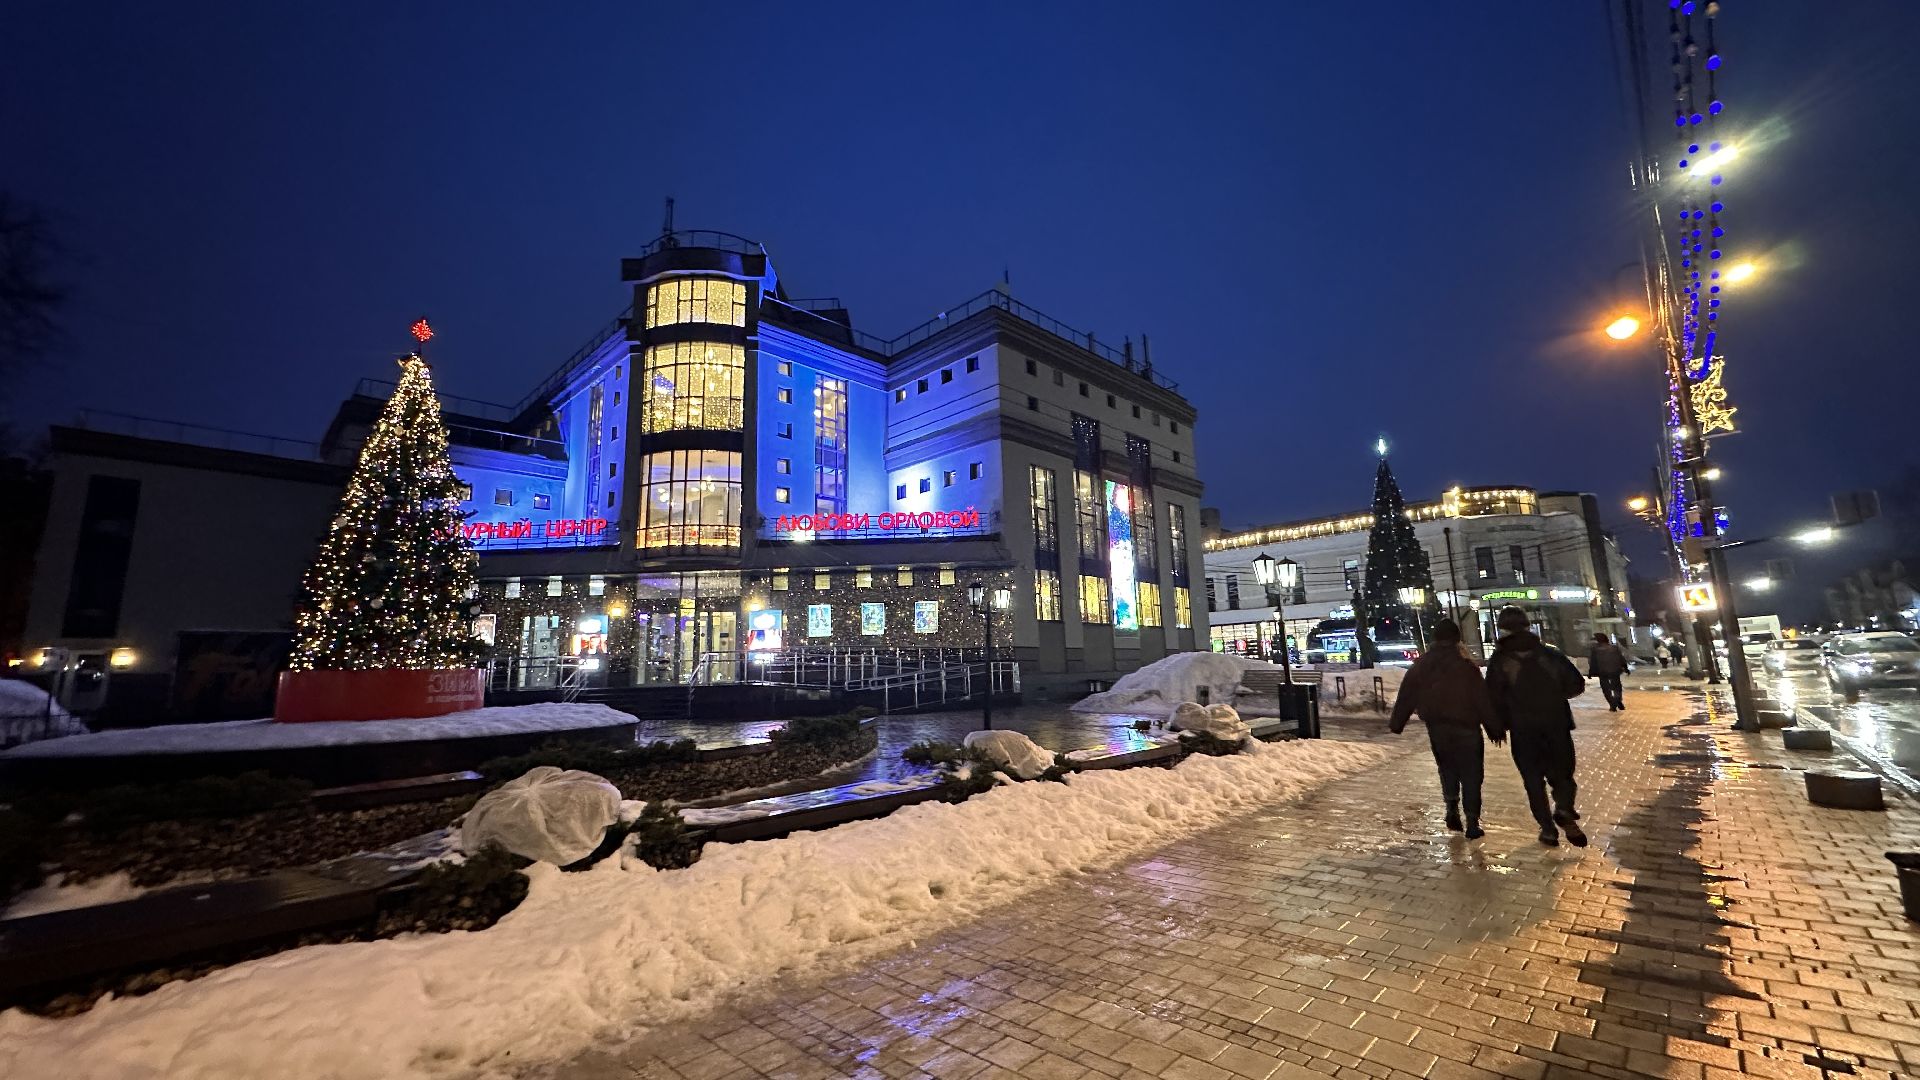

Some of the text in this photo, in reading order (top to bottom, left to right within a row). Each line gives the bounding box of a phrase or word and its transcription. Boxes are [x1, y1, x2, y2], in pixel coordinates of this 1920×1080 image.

[427, 518, 608, 540] УРНЫЙ ЦЕНТР
[775, 506, 979, 532] ЛЮБОВИ ОРЛОВОЙ
